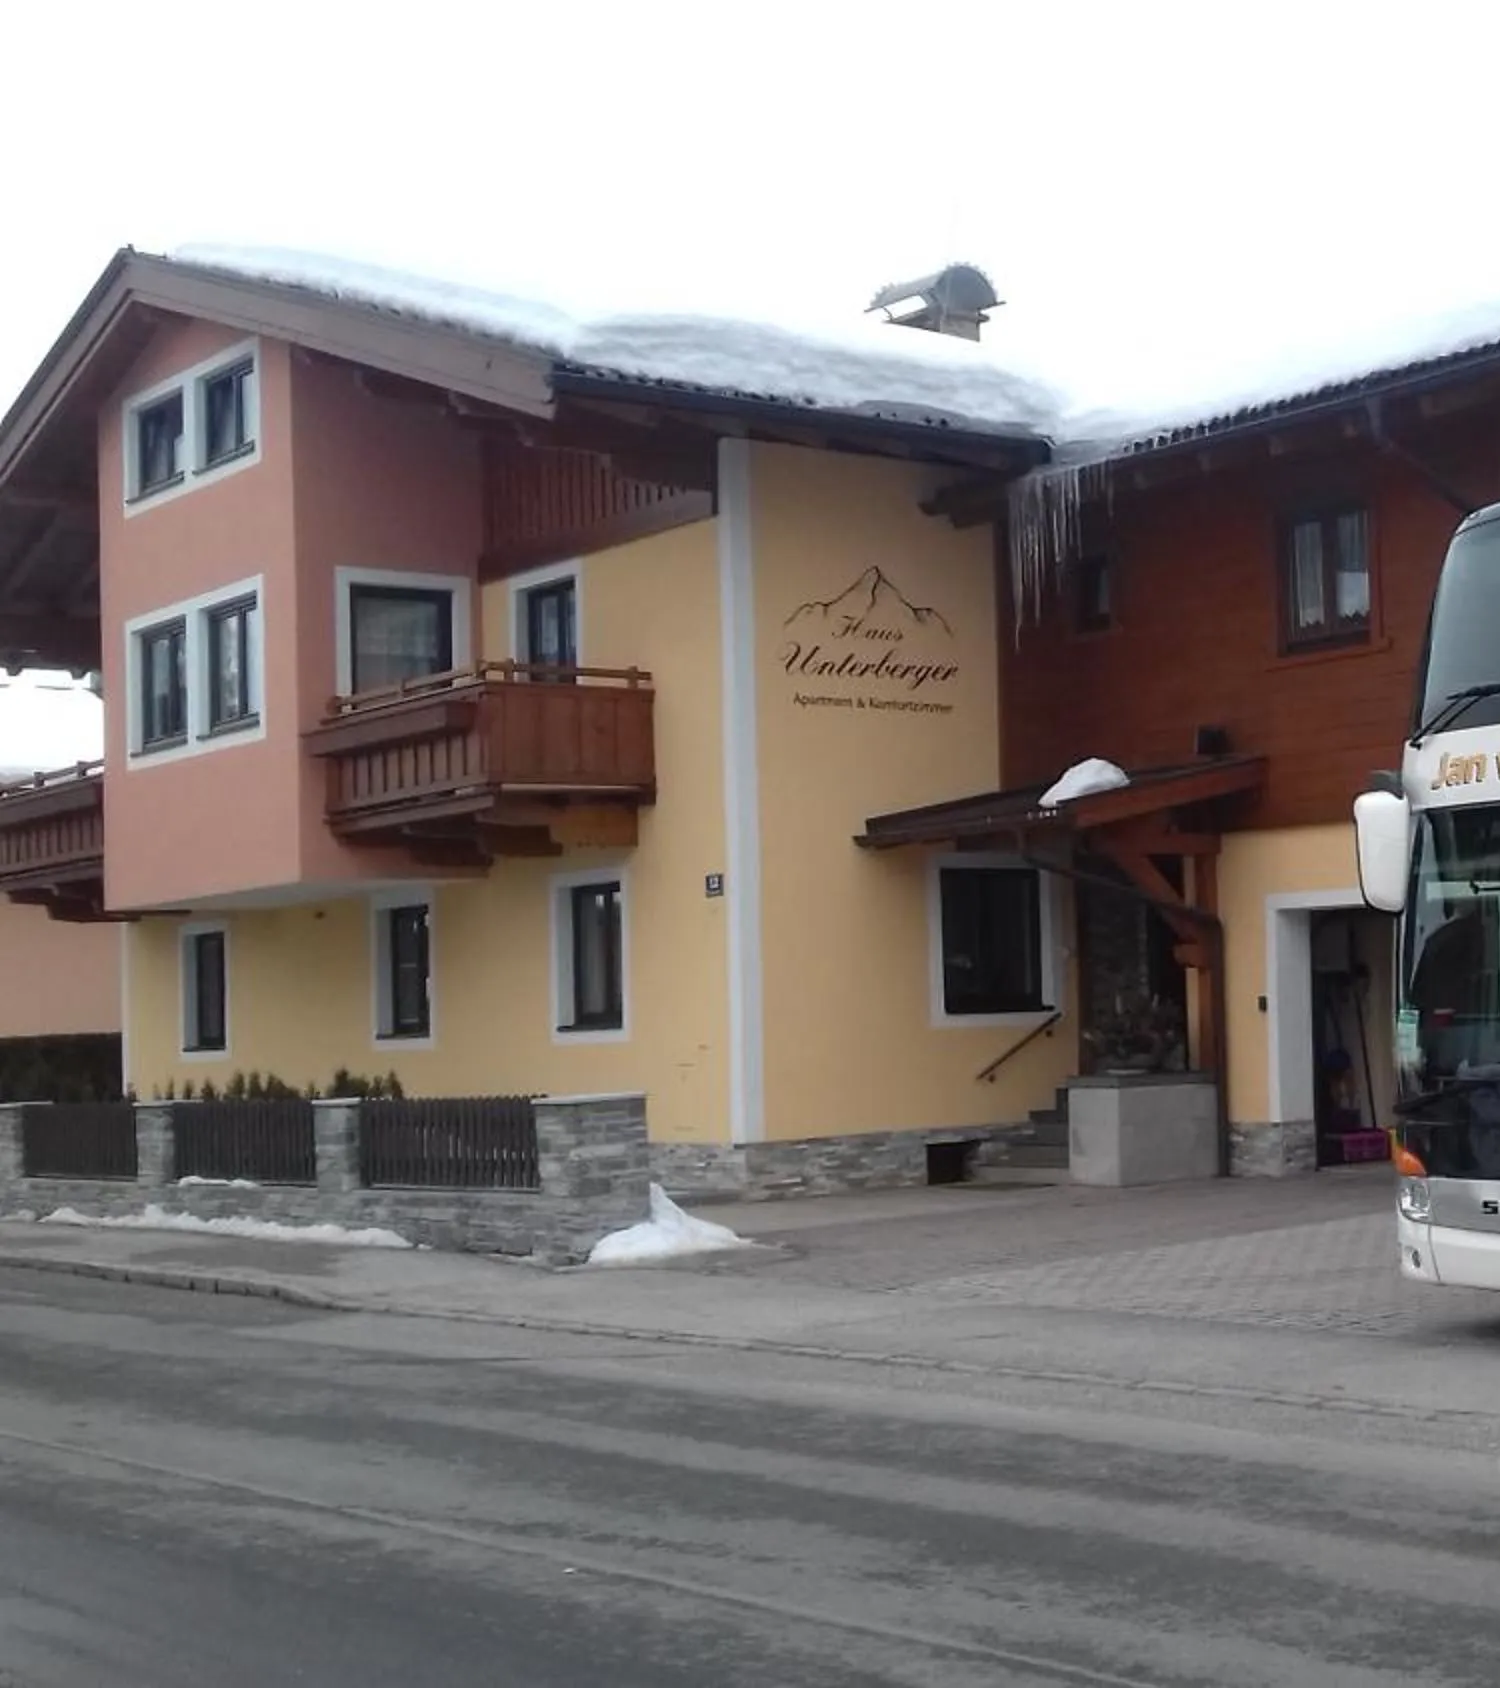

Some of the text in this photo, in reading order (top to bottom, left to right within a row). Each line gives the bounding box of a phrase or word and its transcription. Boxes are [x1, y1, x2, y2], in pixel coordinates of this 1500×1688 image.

[831, 615, 904, 641] Haus
[780, 642, 959, 690] Unterberger
[856, 698, 866, 709] &
[1431, 751, 1488, 790] Jan
